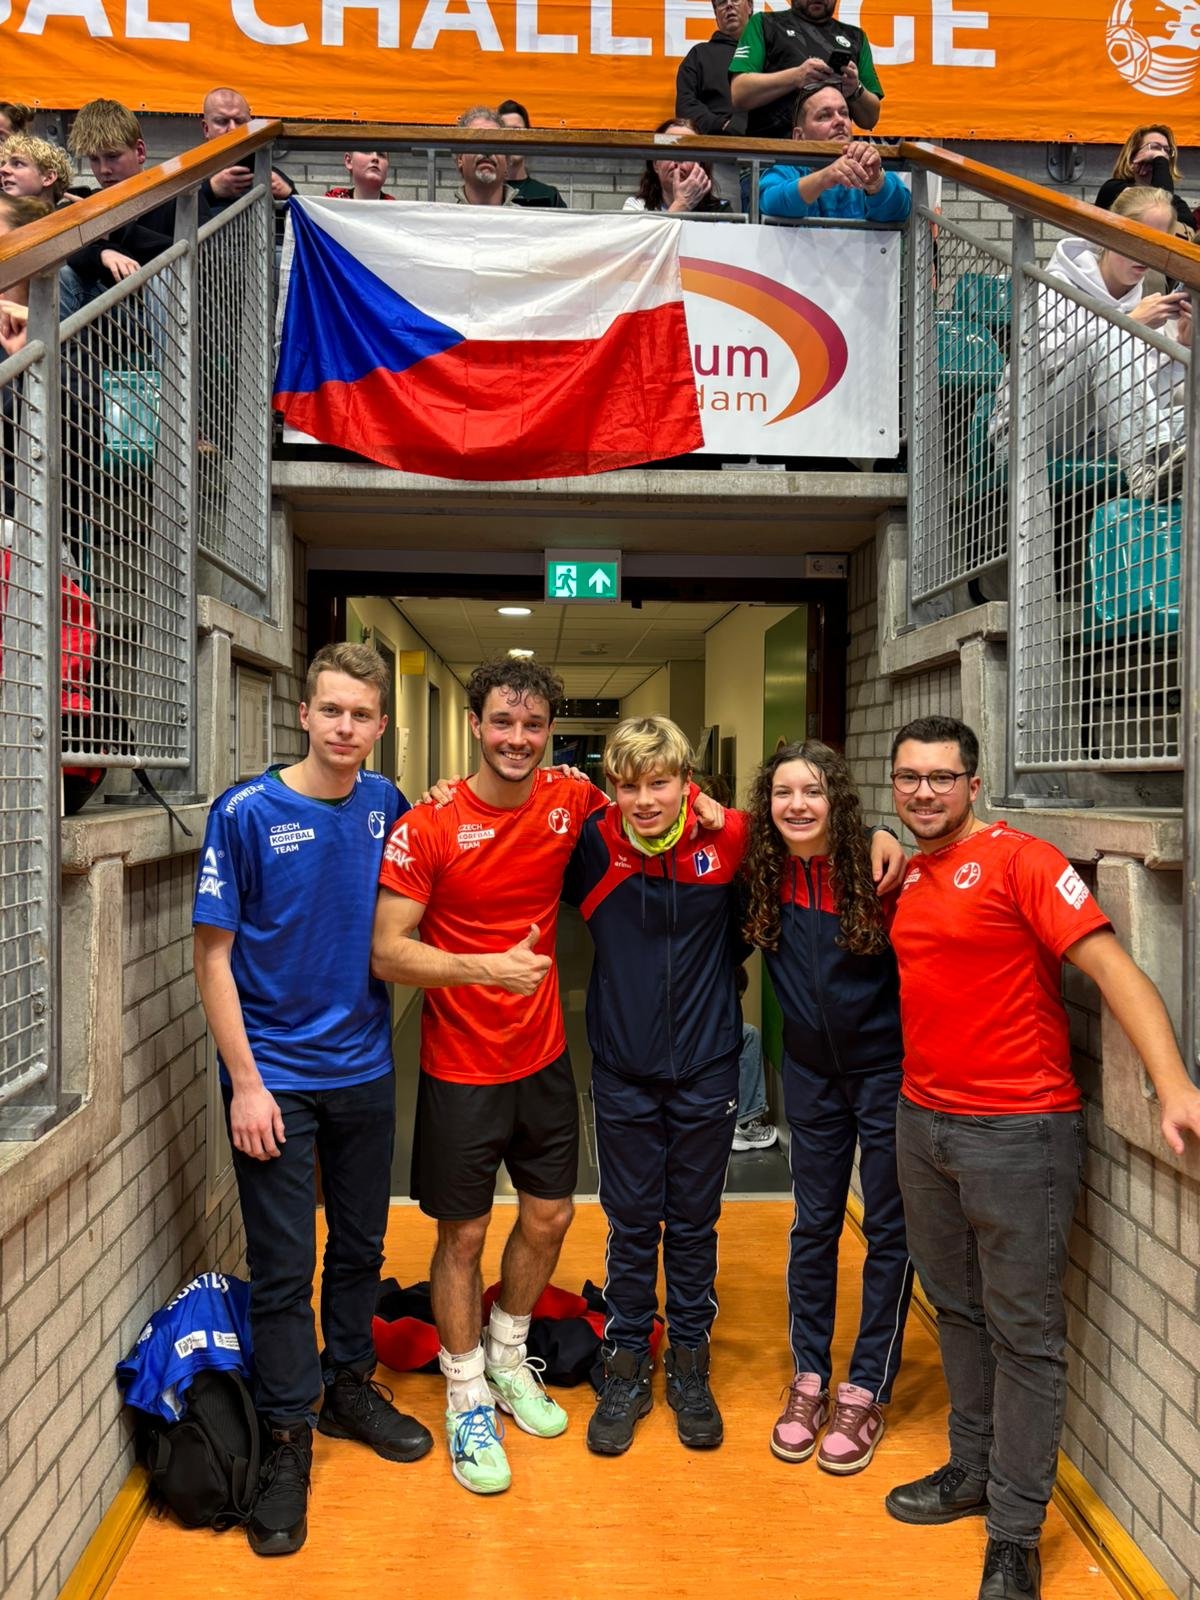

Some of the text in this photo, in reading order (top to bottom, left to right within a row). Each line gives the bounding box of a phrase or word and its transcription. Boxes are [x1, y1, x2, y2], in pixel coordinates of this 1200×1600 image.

[231, 0, 996, 68] CHALLEGE
[270, 822, 300, 834] CZECH
[270, 830, 313, 844] KORFBAL
[273, 843, 299, 855] TEAM
[459, 840, 481, 850] TEAM
